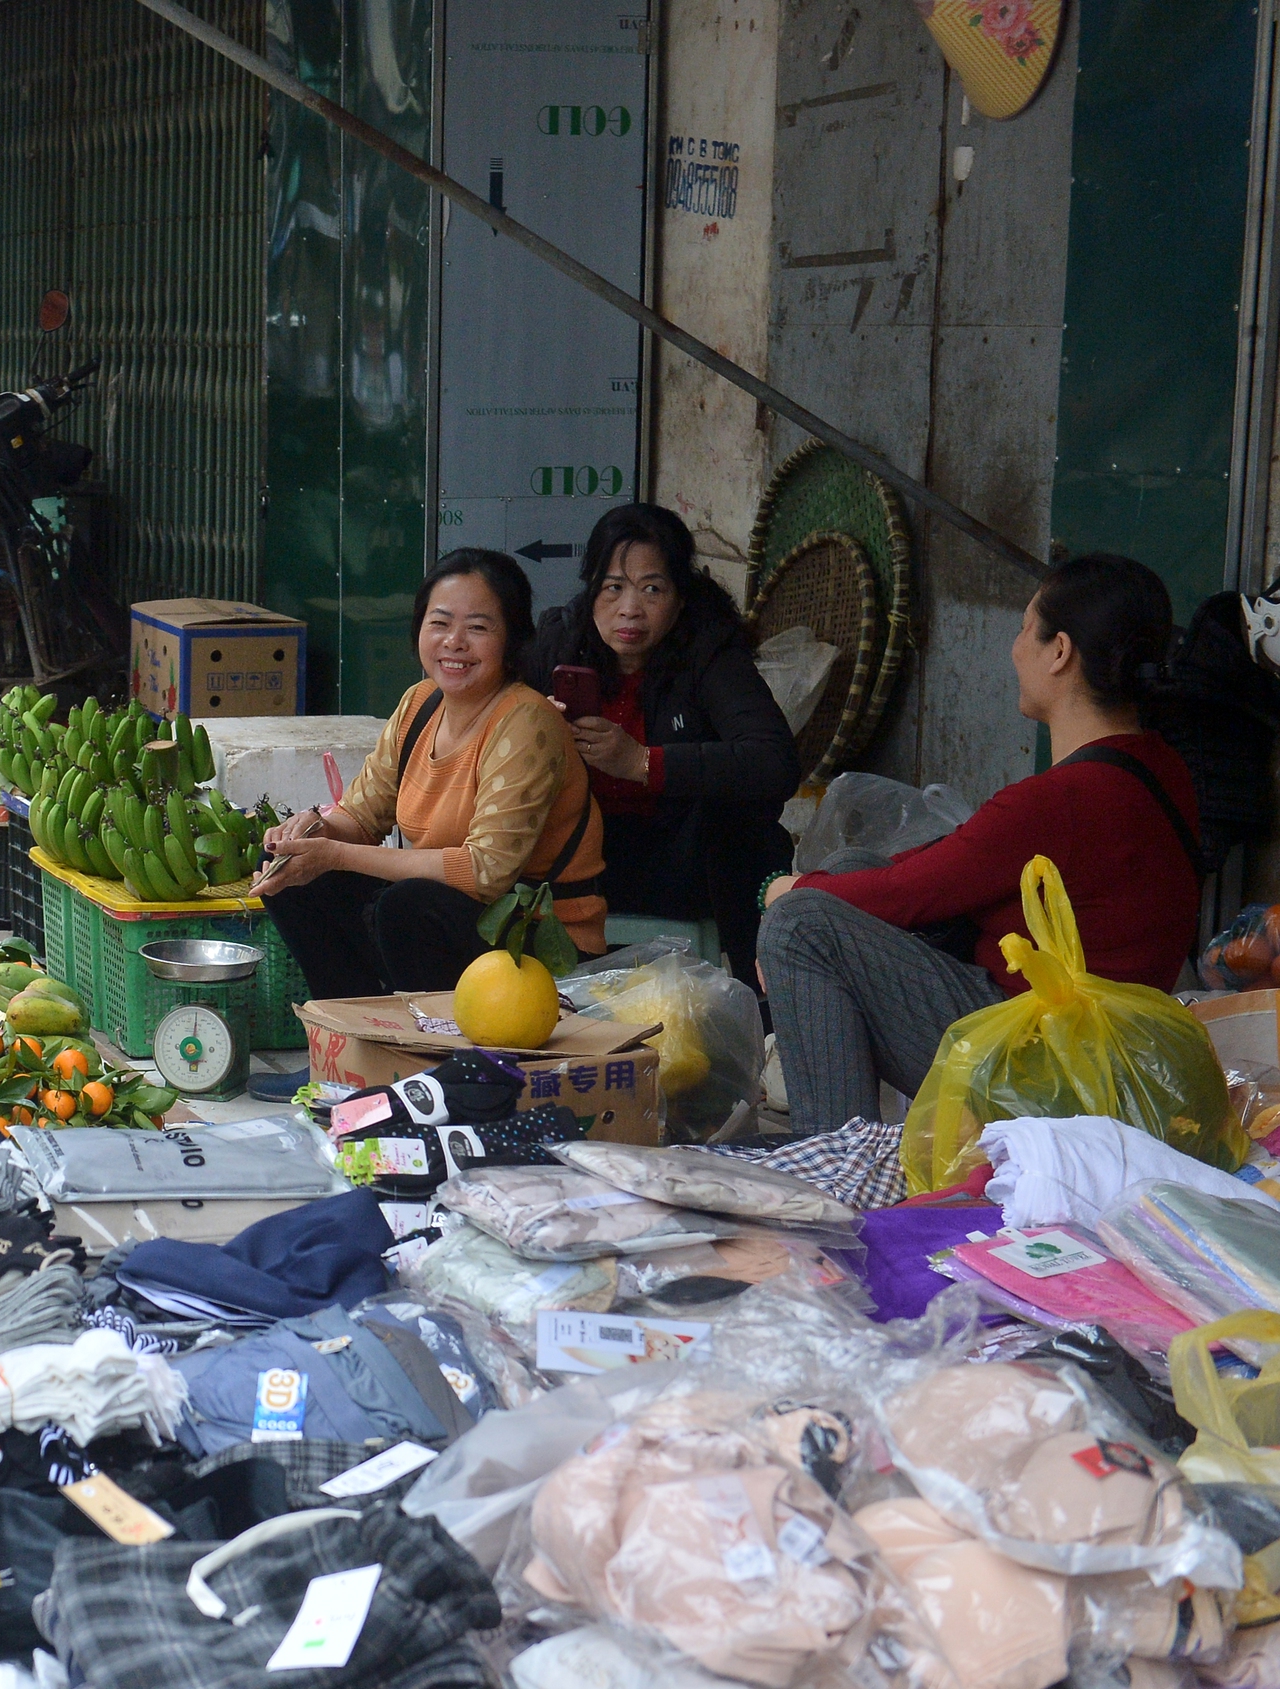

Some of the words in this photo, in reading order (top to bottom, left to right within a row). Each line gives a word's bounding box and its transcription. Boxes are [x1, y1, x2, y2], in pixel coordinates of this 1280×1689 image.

[536, 105, 631, 137] GOLD
[530, 465, 623, 496] GOLD
[517, 1060, 636, 1098] 藏专用
[267, 1372, 296, 1408] 3D
